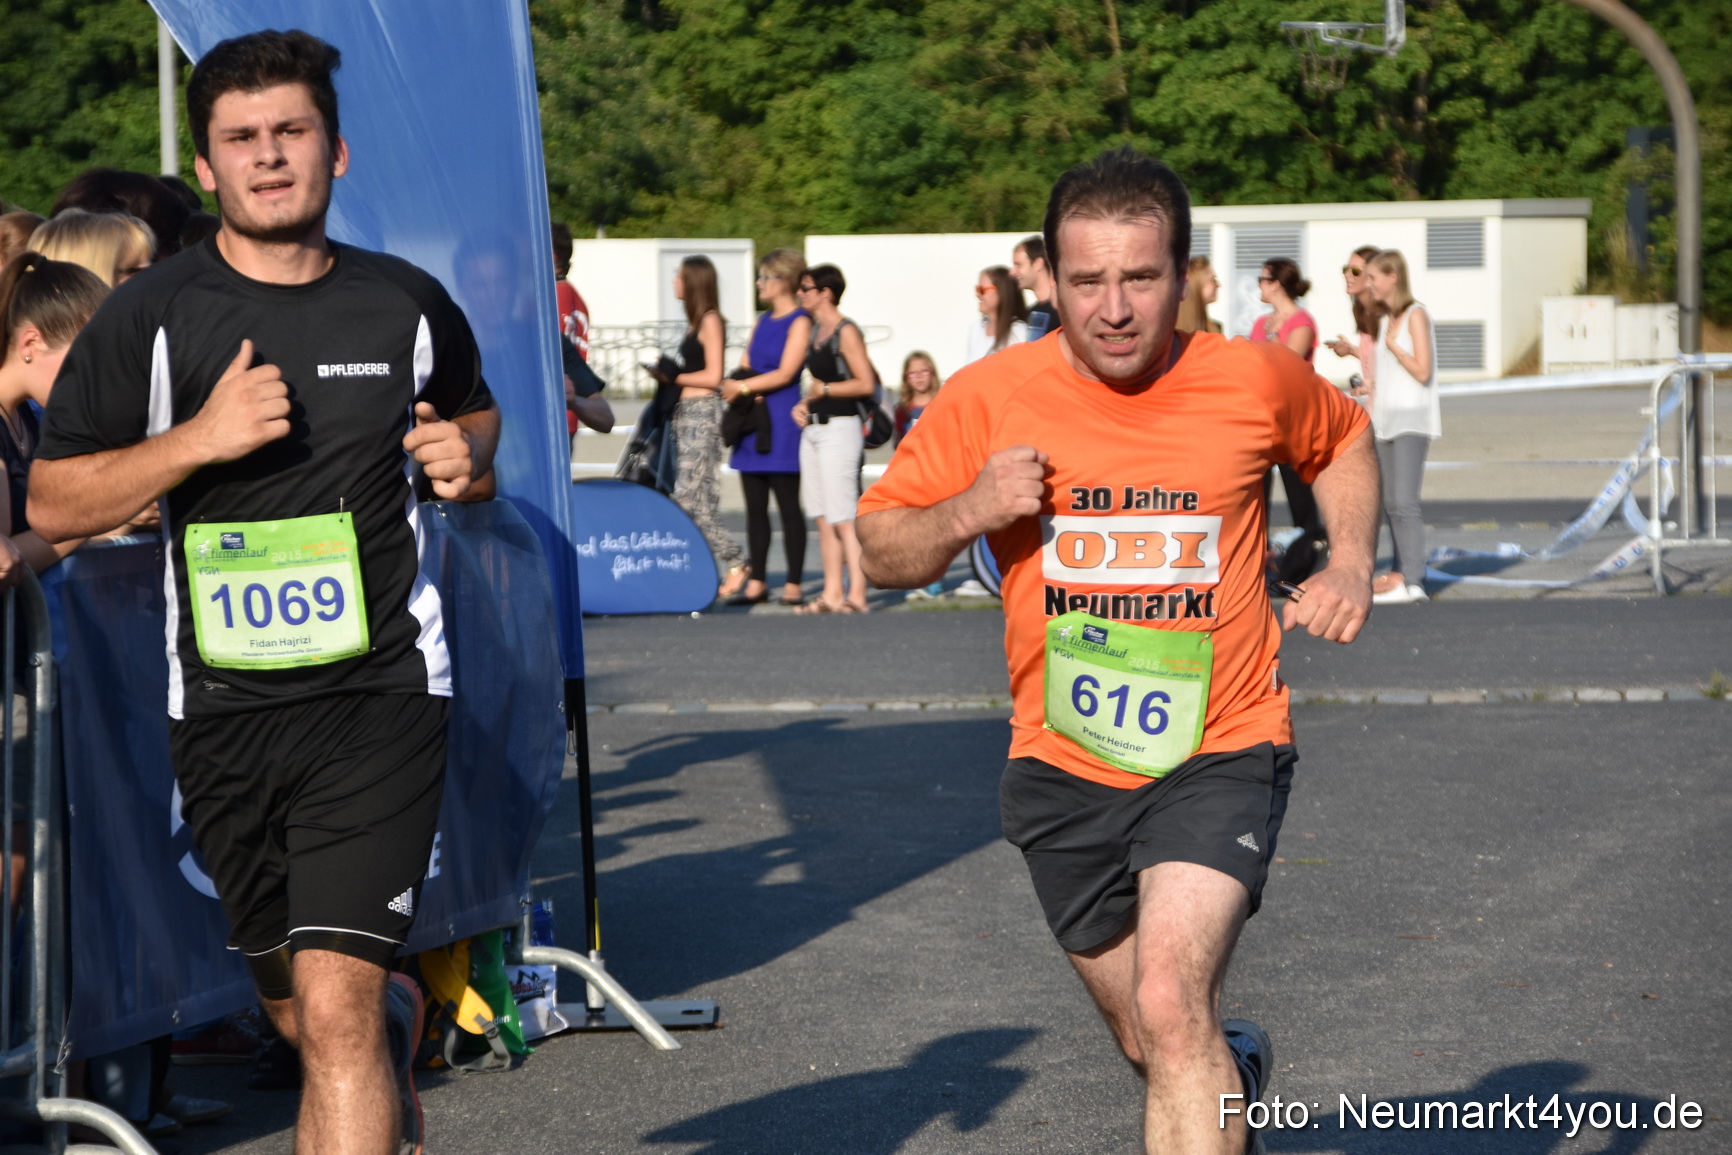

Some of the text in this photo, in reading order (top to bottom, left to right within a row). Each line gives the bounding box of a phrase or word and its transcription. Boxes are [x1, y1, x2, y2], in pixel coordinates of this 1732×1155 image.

[330, 363, 390, 376] PFLEIDERER
[1070, 486, 1199, 511] 30 Jahre
[211, 546, 268, 559] firmenlauf
[599, 531, 630, 552] das
[1056, 531, 1208, 569] OBI
[211, 576, 345, 629] 1069
[1044, 584, 1216, 621] Neumarkt
[249, 635, 312, 648] Fidan Hajrizi
[1070, 635, 1129, 658] firmenlauf
[1128, 656, 1160, 670] 2015
[1071, 674, 1172, 735] 616
[1082, 726, 1147, 753] Peter Heidner
